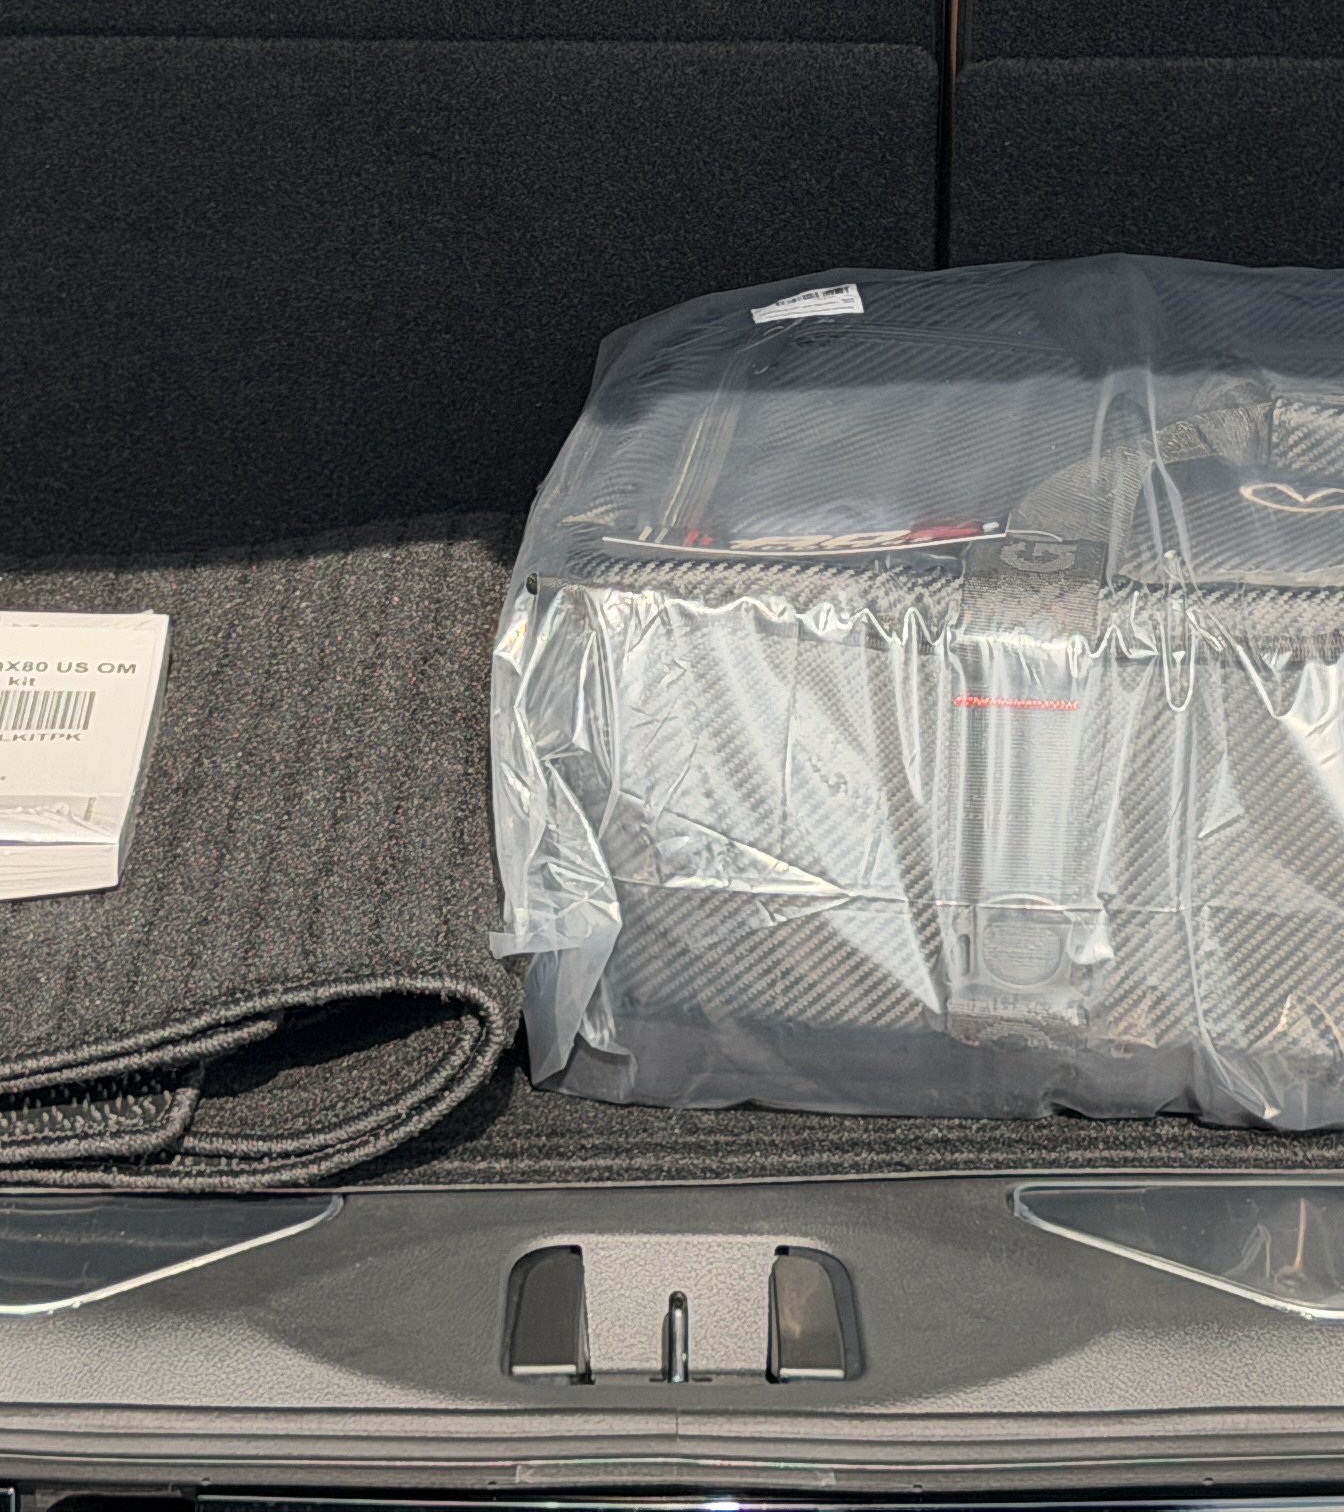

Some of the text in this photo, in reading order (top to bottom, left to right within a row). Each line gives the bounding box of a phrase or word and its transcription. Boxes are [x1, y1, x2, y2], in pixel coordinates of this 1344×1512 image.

[56, 661, 90, 674] US
[96, 662, 138, 675] OM
[7, 676, 38, 687] kit
